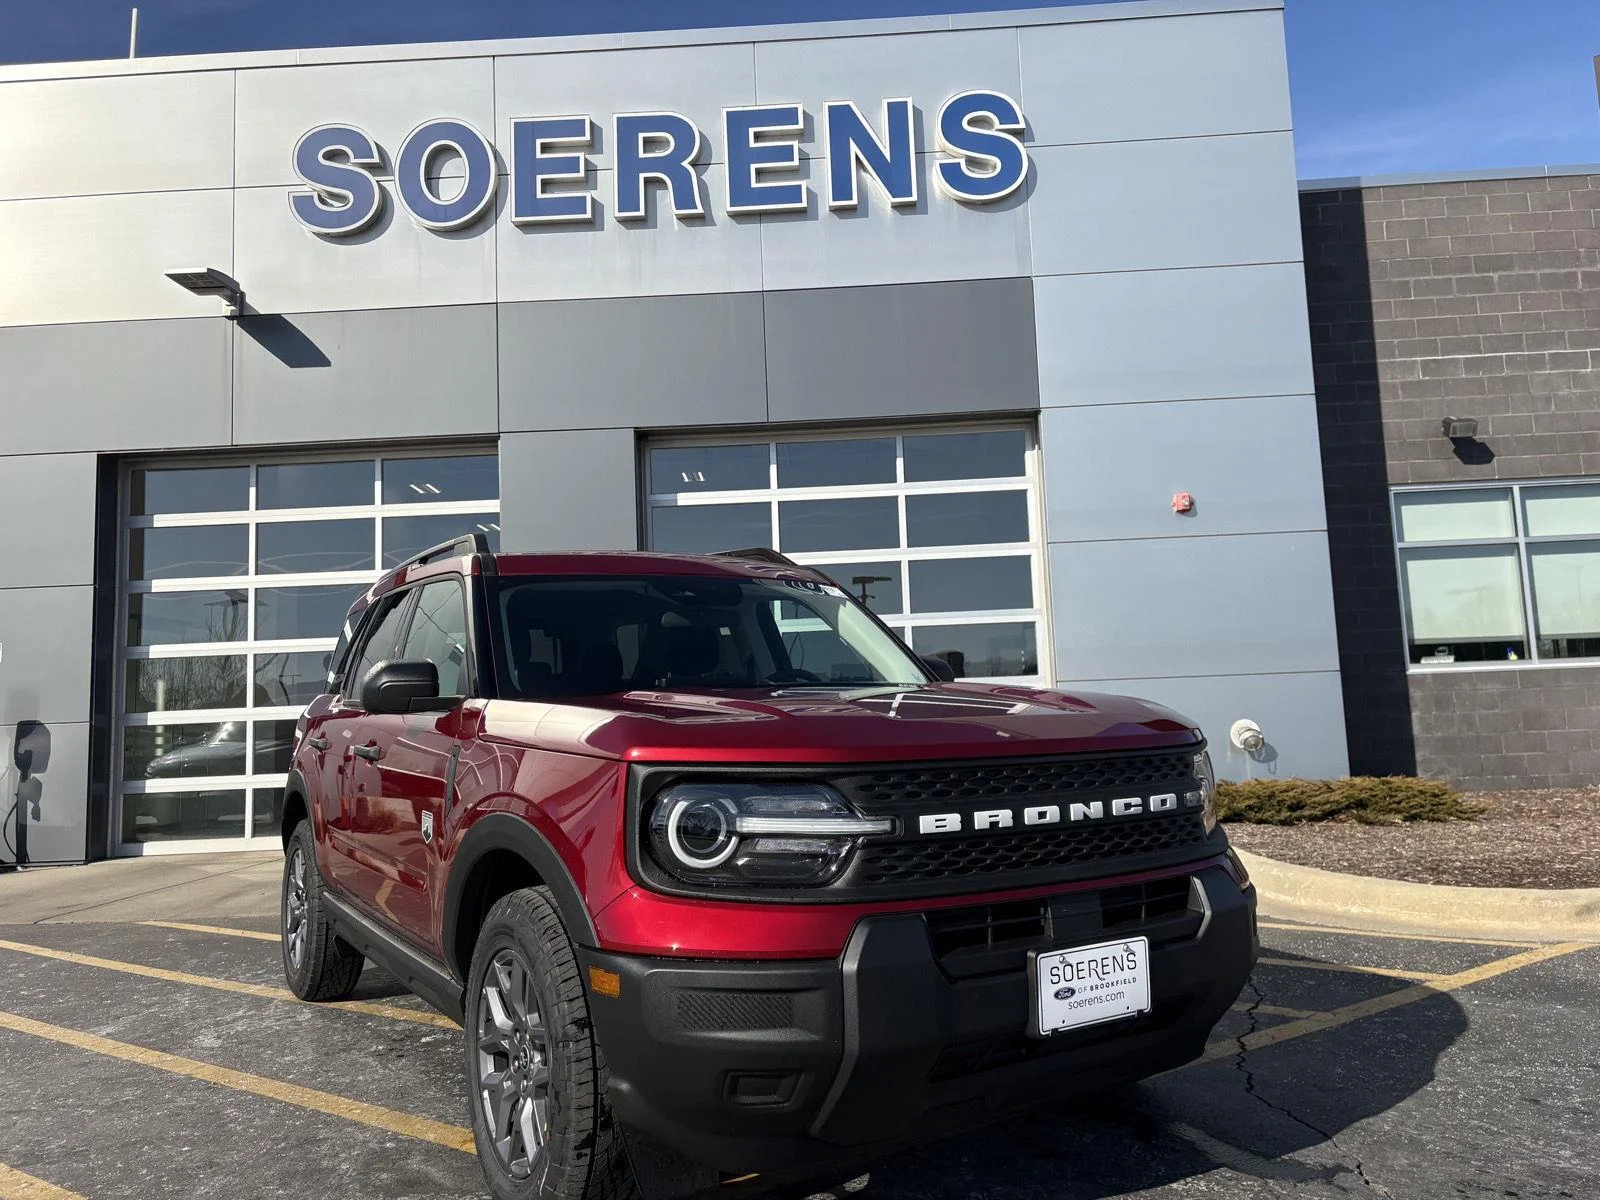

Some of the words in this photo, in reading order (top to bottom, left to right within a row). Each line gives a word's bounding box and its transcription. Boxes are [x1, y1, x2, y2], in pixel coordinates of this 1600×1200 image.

[288, 89, 1029, 237] SOERENS
[919, 793, 1177, 834] BRONCO
[1050, 952, 1137, 985] SOERENS
[1068, 990, 1125, 1010] soerens.com
[1078, 986, 1088, 994] OF
[1089, 977, 1137, 991] BROOKFIELD
